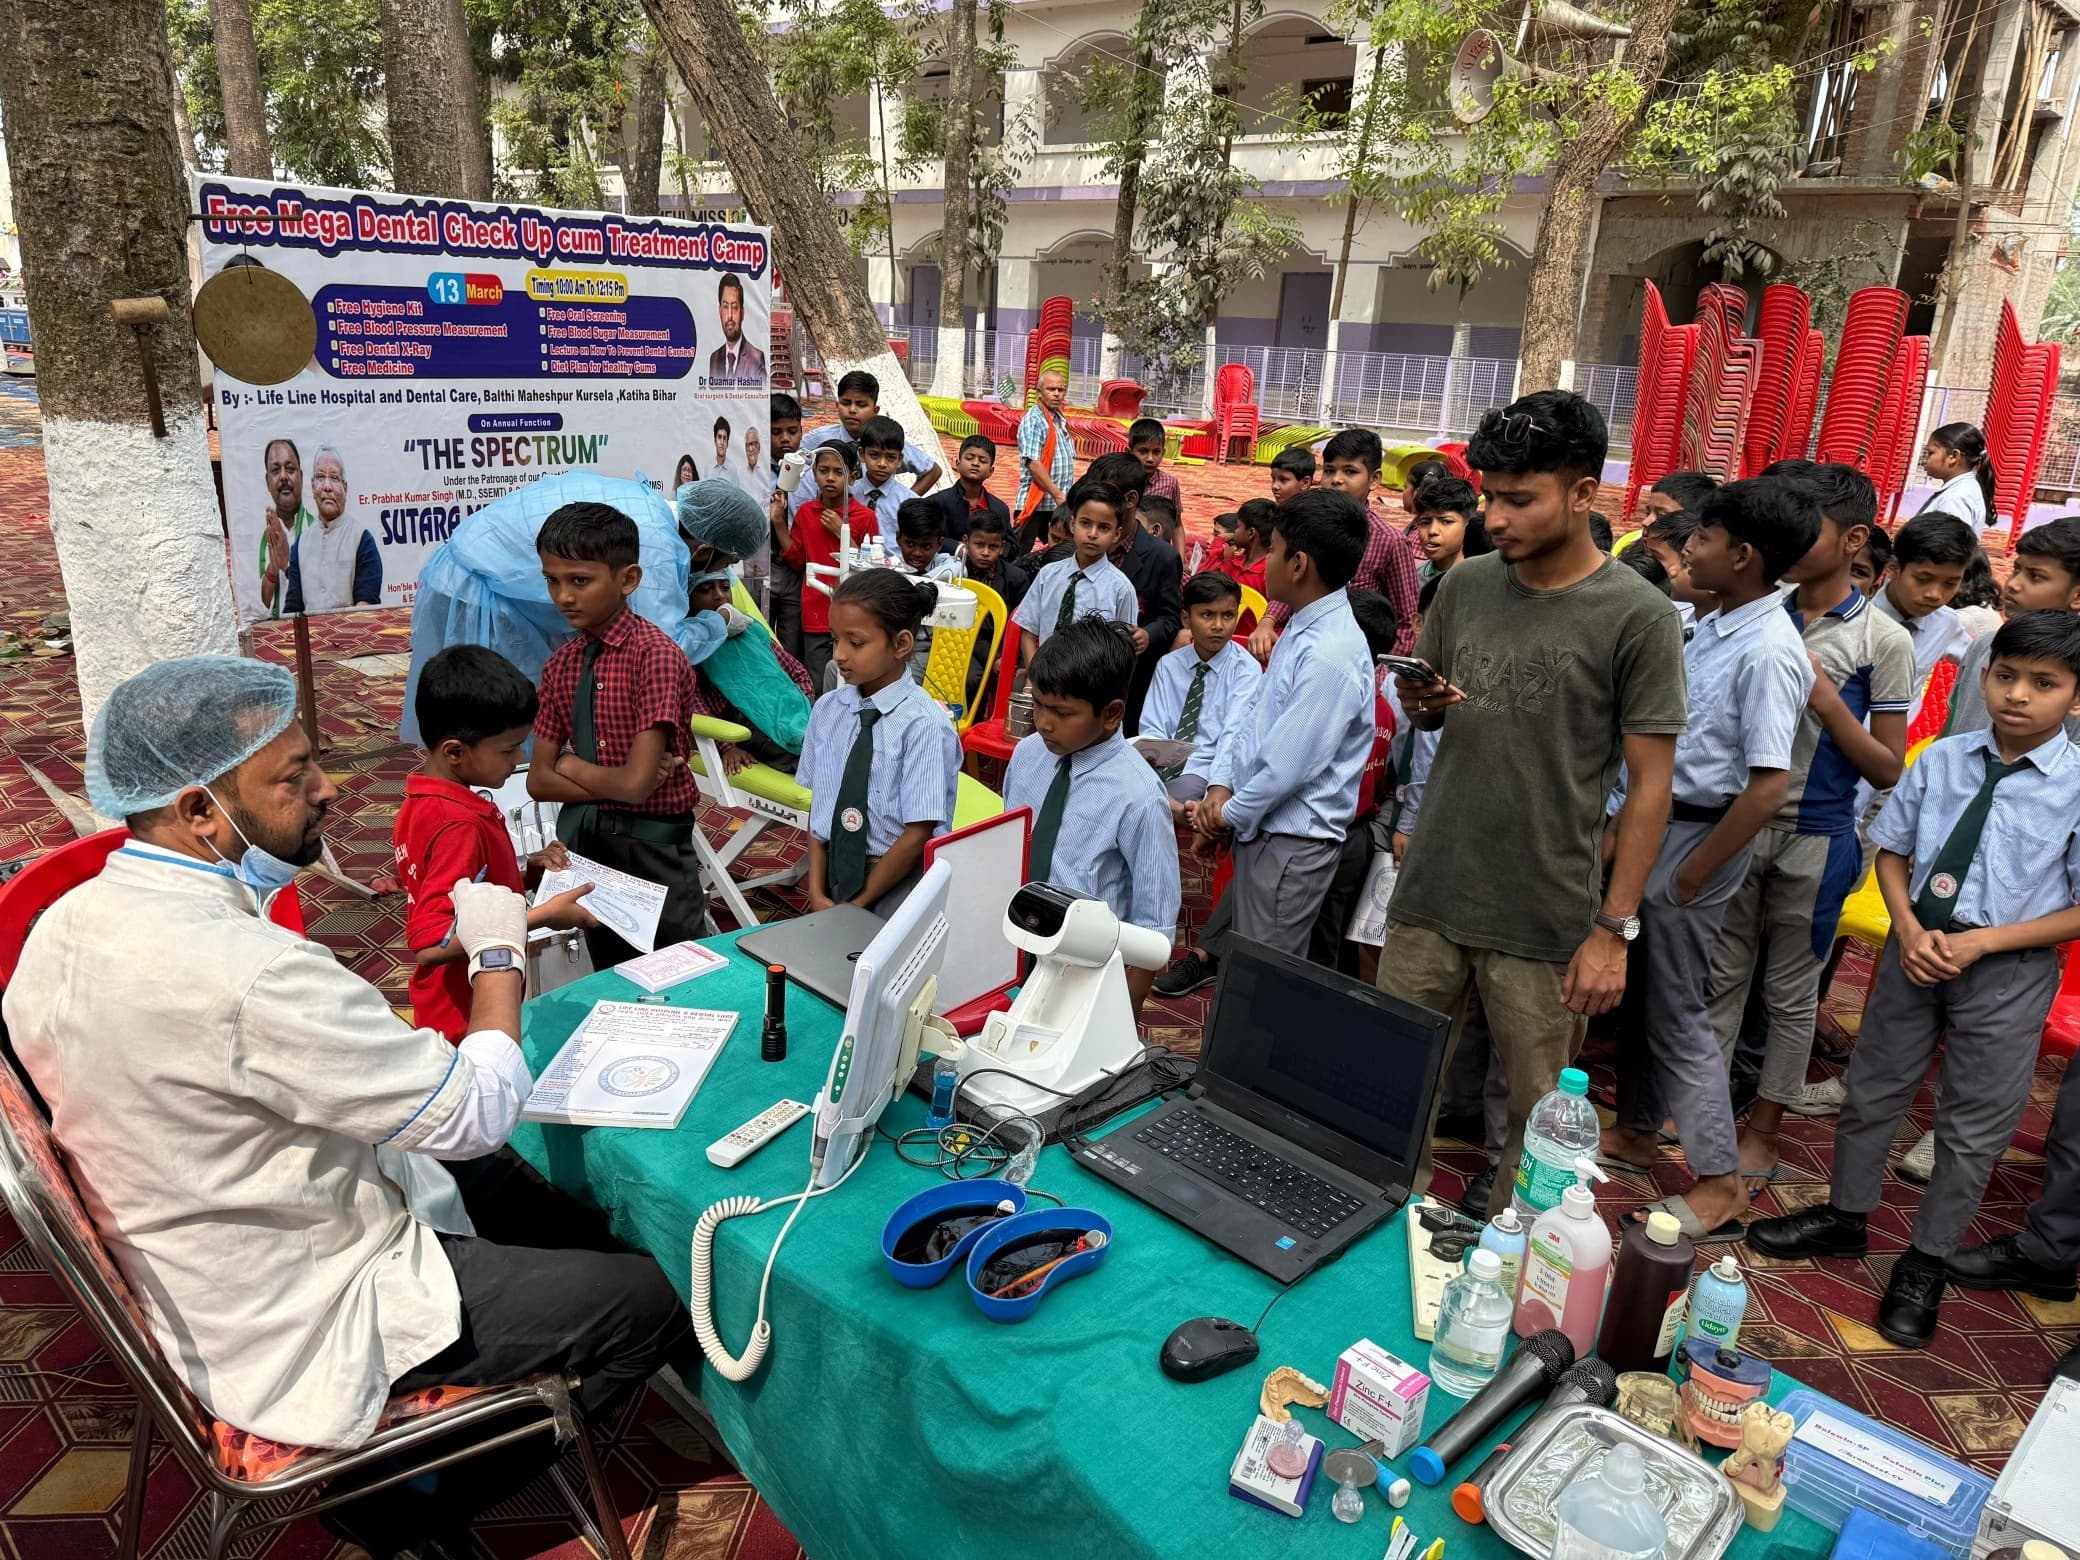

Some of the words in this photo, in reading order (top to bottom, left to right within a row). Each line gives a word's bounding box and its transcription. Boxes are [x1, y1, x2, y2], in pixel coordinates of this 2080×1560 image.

[208, 195, 273, 233] Free
[278, 200, 353, 246] Mega
[356, 205, 439, 244] Dental
[444, 209, 518, 250] Check
[521, 217, 553, 258] Up
[558, 229, 603, 254] cum
[607, 224, 708, 267] Treatment
[711, 231, 764, 272] Camp
[435, 278, 460, 304] 13
[466, 281, 503, 300] March
[531, 276, 553, 300] Timing
[555, 279, 573, 296] 10:00
[574, 280, 585, 296] Am
[586, 281, 595, 296] To
[596, 281, 613, 297] 12:15
[614, 283, 625, 297] Pm
[336, 299, 360, 314] Free
[362, 300, 405, 317] Hygiene
[407, 301, 423, 316] Kit
[547, 308, 567, 321] Free
[567, 309, 585, 322] Oral
[586, 310, 626, 325] Screening
[337, 320, 362, 335] Free
[364, 320, 394, 335] Blood
[396, 321, 441, 336] Pressure
[443, 322, 507, 337] Measurement
[548, 325, 567, 338] Free
[568, 326, 592, 338] Blood
[593, 327, 617, 341] Sugar
[618, 328, 670, 341] Measurement
[339, 341, 364, 356] Free
[366, 342, 399, 356] Dental
[402, 343, 432, 359] X-Ray
[550, 344, 578, 356] Lecture
[580, 346, 589, 356] on
[590, 345, 607, 356] How
[607, 345, 617, 356] To
[617, 346, 644, 357] Prevent
[645, 346, 667, 357] Dental
[341, 361, 366, 375] Free
[367, 362, 414, 375] Medicine
[551, 360, 569, 373] Diet
[570, 361, 588, 373] Plan
[589, 361, 602, 373] for
[602, 362, 633, 375] Healthy
[634, 363, 656, 374] Gums
[698, 376, 707, 386] Dr
[709, 376, 736, 386] Quamar
[737, 376, 763, 386] Hashmi
[221, 390, 239, 409] By
[244, 394, 253, 405] :-
[257, 389, 284, 405] Life
[287, 389, 317, 405] Line
[320, 389, 375, 407] Hospital
[380, 389, 403, 404] and
[406, 389, 446, 404] Dental
[449, 388, 481, 406] Care,
[518, 389, 573, 404] Maheshpur
[576, 389, 614, 401] Kursela
[652, 389, 677, 401] Bihar
[480, 419, 490, 428] On
[492, 418, 517, 428] Annual
[519, 418, 551, 427] Function
[443, 475, 466, 486] Under
[467, 475, 480, 485] the
[481, 473, 517, 485] Patronage
[519, 472, 527, 482] of
[528, 473, 540, 482] our
[359, 494, 370, 505] Er.
[372, 492, 404, 504] Prabhat
[404, 492, 430, 503] Kumar
[431, 490, 454, 503] Singh
[455, 489, 477, 502] (M.D.,
[478, 487, 508, 499] SSEMT)
[387, 582, 412, 592] Hon'ble
[1454, 640, 1580, 714] CRAZY
[1547, 1231, 1560, 1244] 3M
[1371, 1363, 1391, 1380] Zinc
[1355, 1379, 1376, 1399] Zinc
